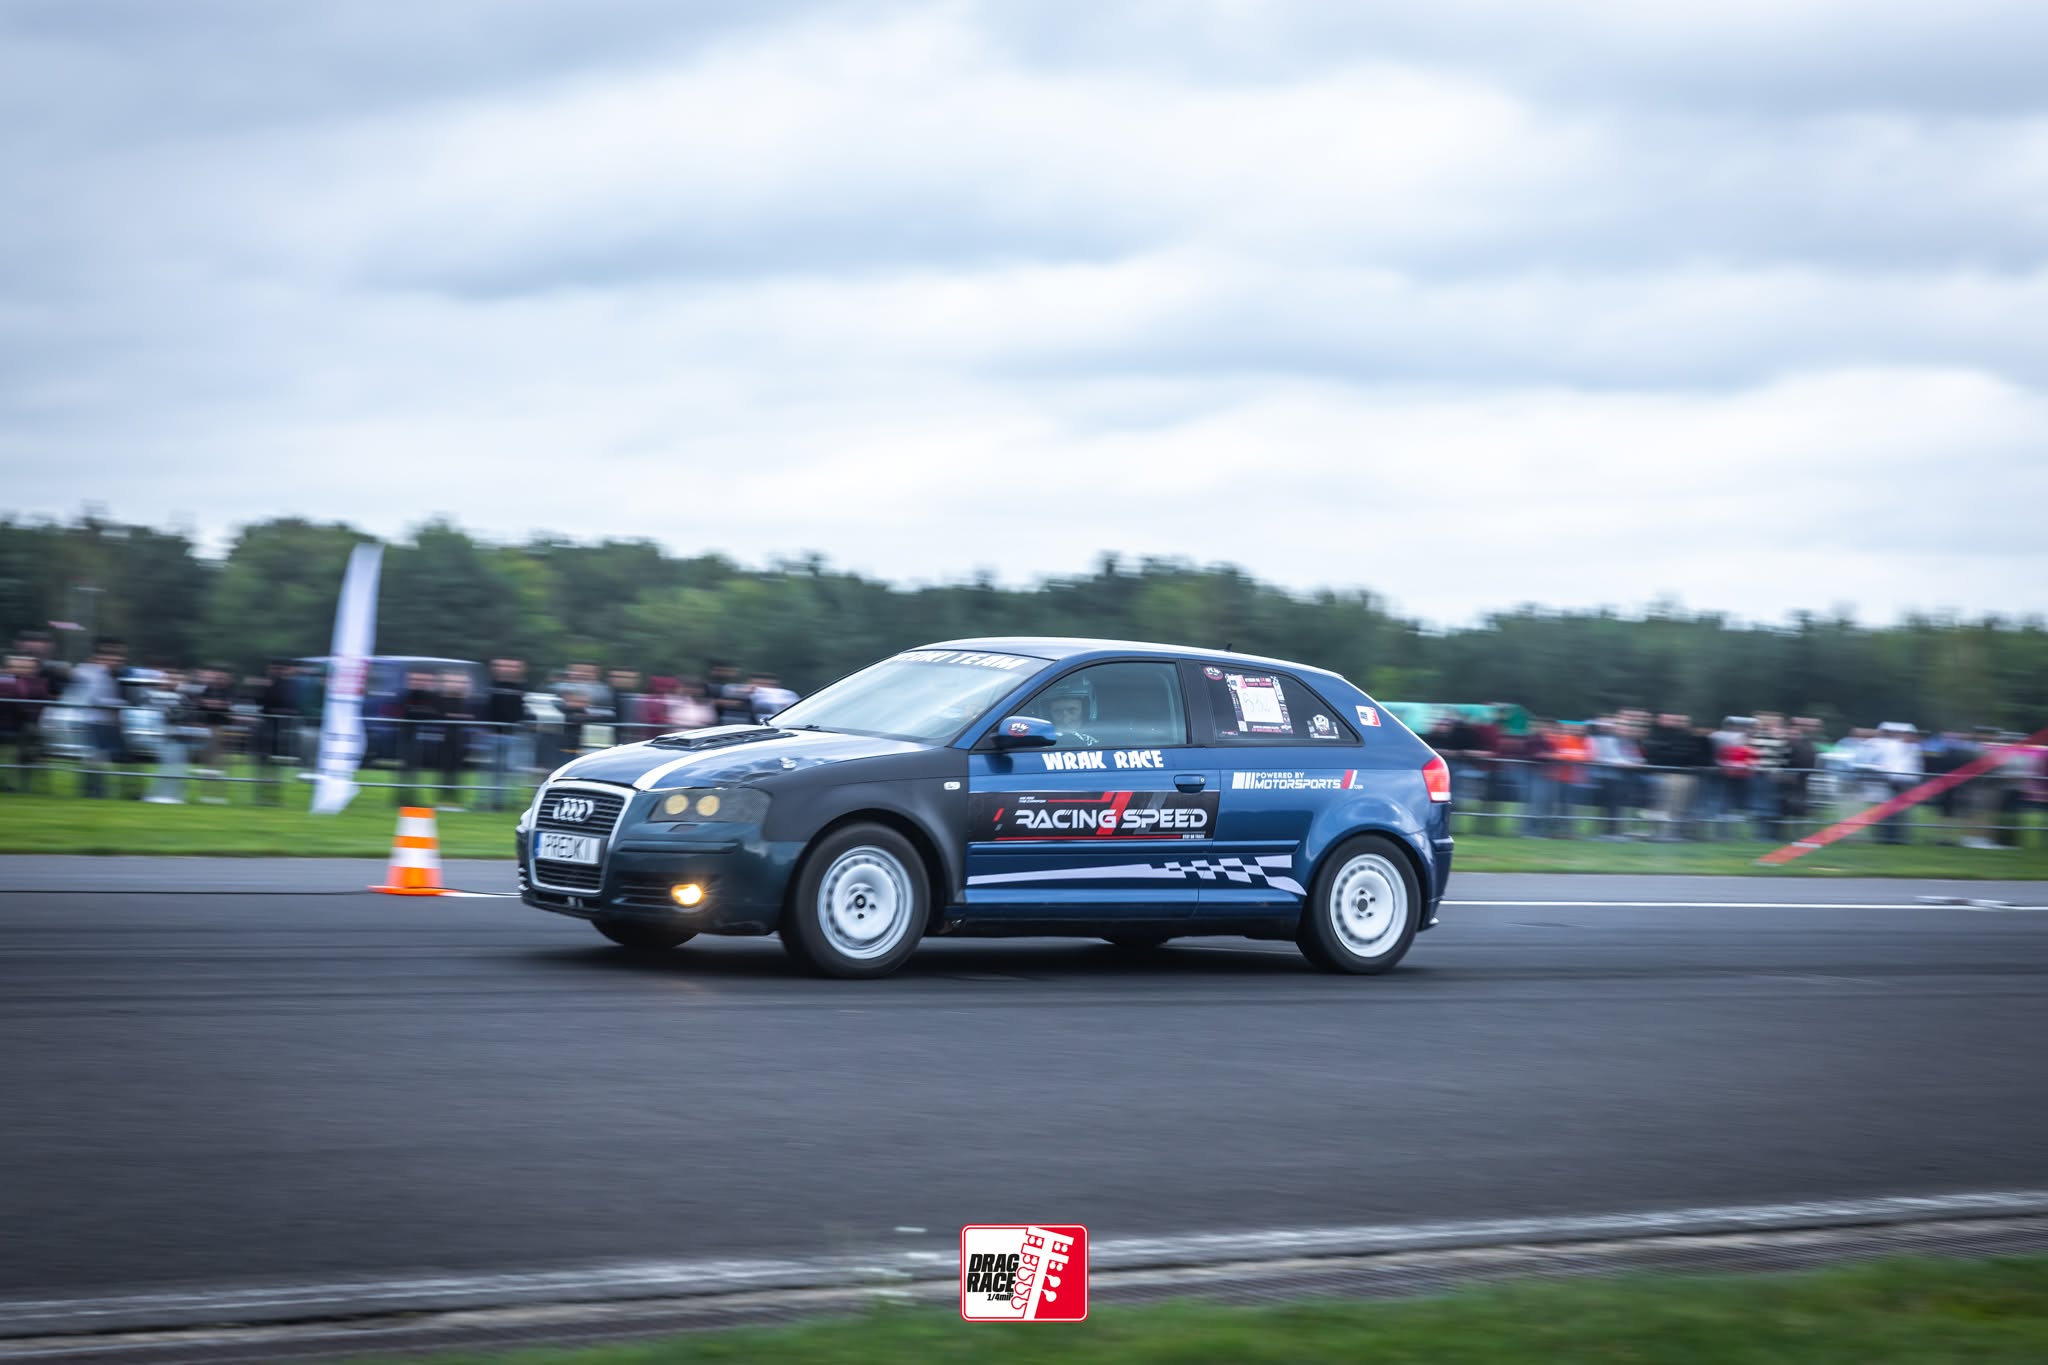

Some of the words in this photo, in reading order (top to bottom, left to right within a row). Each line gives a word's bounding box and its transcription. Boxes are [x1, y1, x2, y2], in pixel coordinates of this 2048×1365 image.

[948, 653, 1030, 670] TEAM
[1041, 751, 1107, 770] WRAK
[1113, 750, 1164, 769] RACE
[1255, 779, 1341, 789] MOTORSPORTS
[1014, 809, 1117, 828] RACING
[1121, 809, 1207, 828] SPEED
